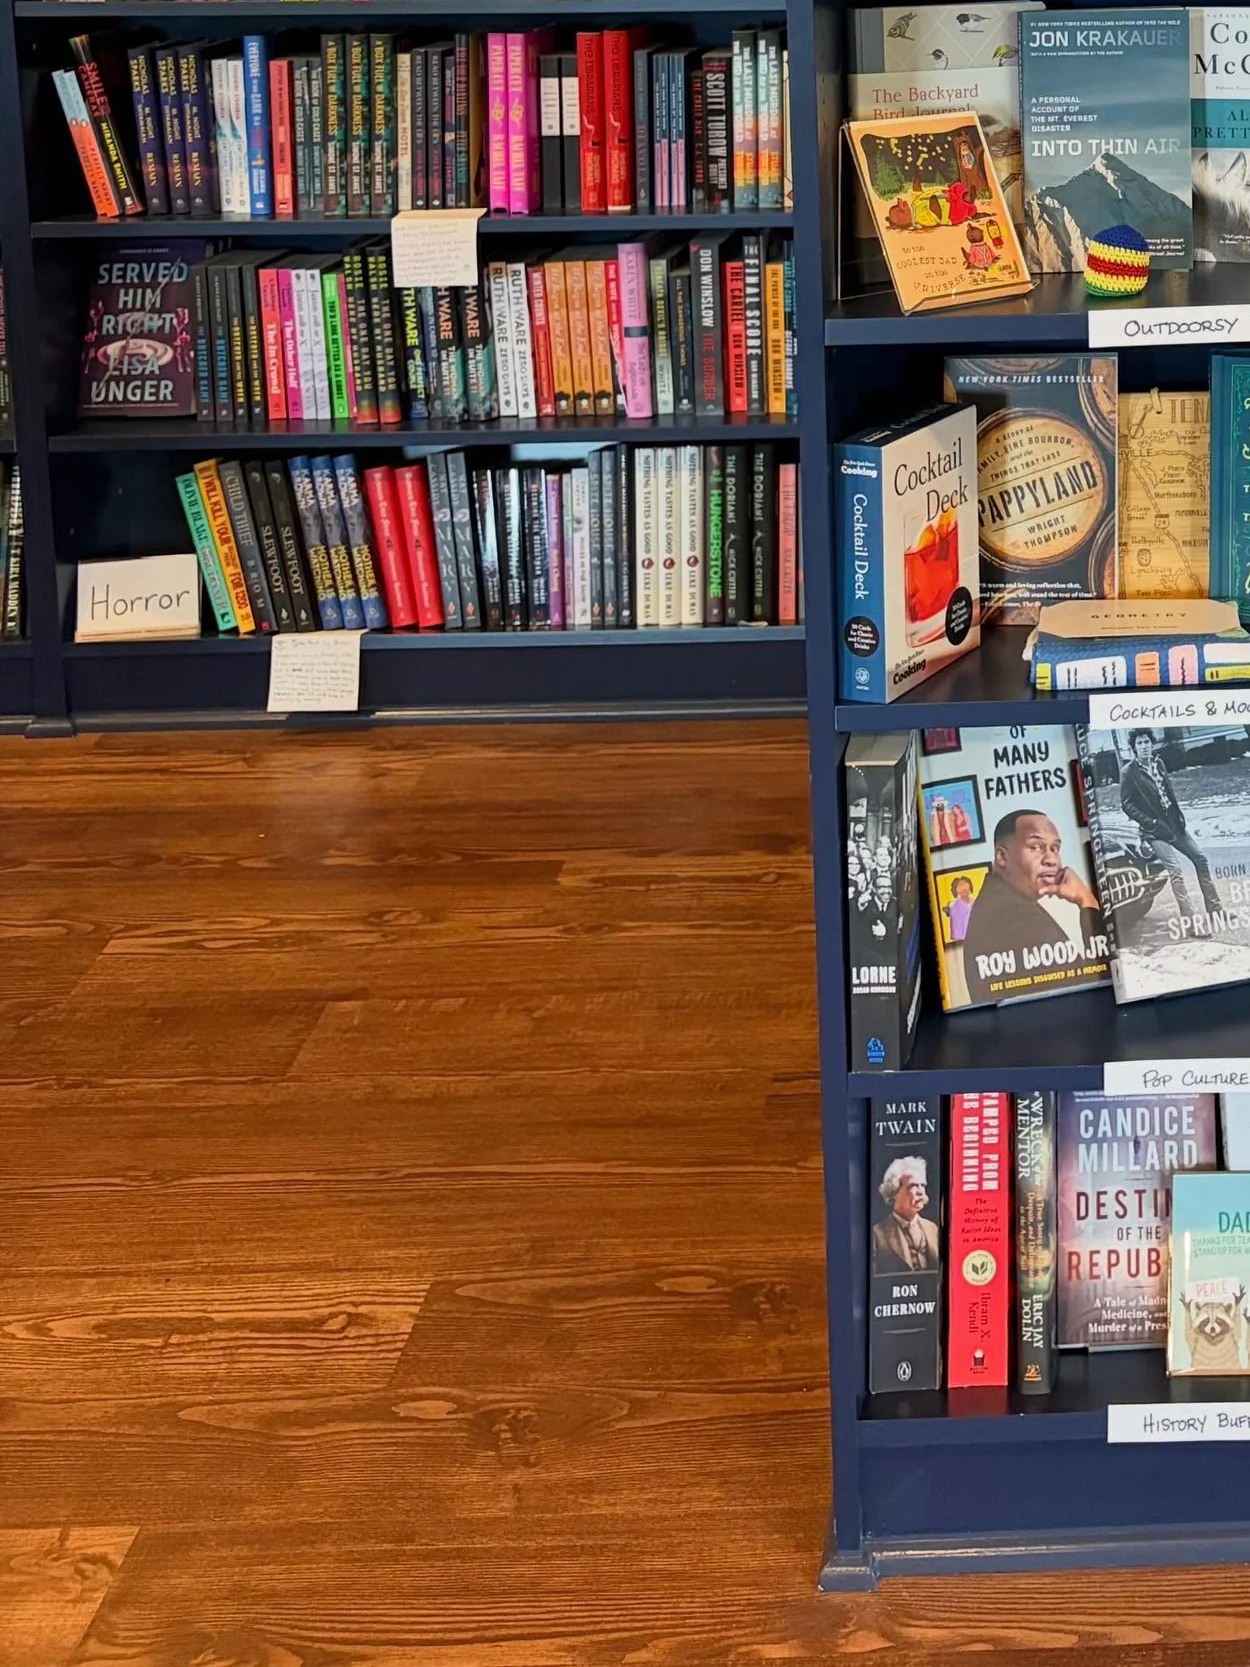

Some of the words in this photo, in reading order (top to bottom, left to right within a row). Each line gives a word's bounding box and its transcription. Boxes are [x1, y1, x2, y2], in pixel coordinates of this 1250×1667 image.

[1029, 30, 1069, 48] JON
[1076, 29, 1182, 47] KRAKAUER
[1031, 140, 1082, 157] INTO
[1088, 139, 1138, 156] THIN
[1144, 139, 1182, 155] AIR
[98, 262, 189, 285] SERVED
[117, 290, 163, 310] HIM
[102, 314, 175, 334] RIGHT
[107, 357, 160, 376] LISA
[90, 380, 174, 402] UNGER
[893, 438, 964, 496] Cocktail
[926, 477, 969, 523] Deck
[90, 582, 190, 620] Horror
[1207, 701, 1220, 715] &
[993, 741, 1051, 769] MANY
[984, 767, 1068, 801] FATHERS
[1214, 865, 1247, 880] BORN
[976, 951, 1017, 980] ROY
[1022, 940, 1081, 971] WOOD
[851, 965, 897, 985] LORNE
[885, 1101, 928, 1115] MARK
[875, 1118, 937, 1136] TWAIN
[1079, 1106, 1196, 1138] CANDICE
[1078, 1140, 1199, 1174] MILLARD
[892, 1285, 918, 1298] RON
[874, 1302, 936, 1318] CHERNOW
[1142, 1412, 1207, 1433] HISTORY
